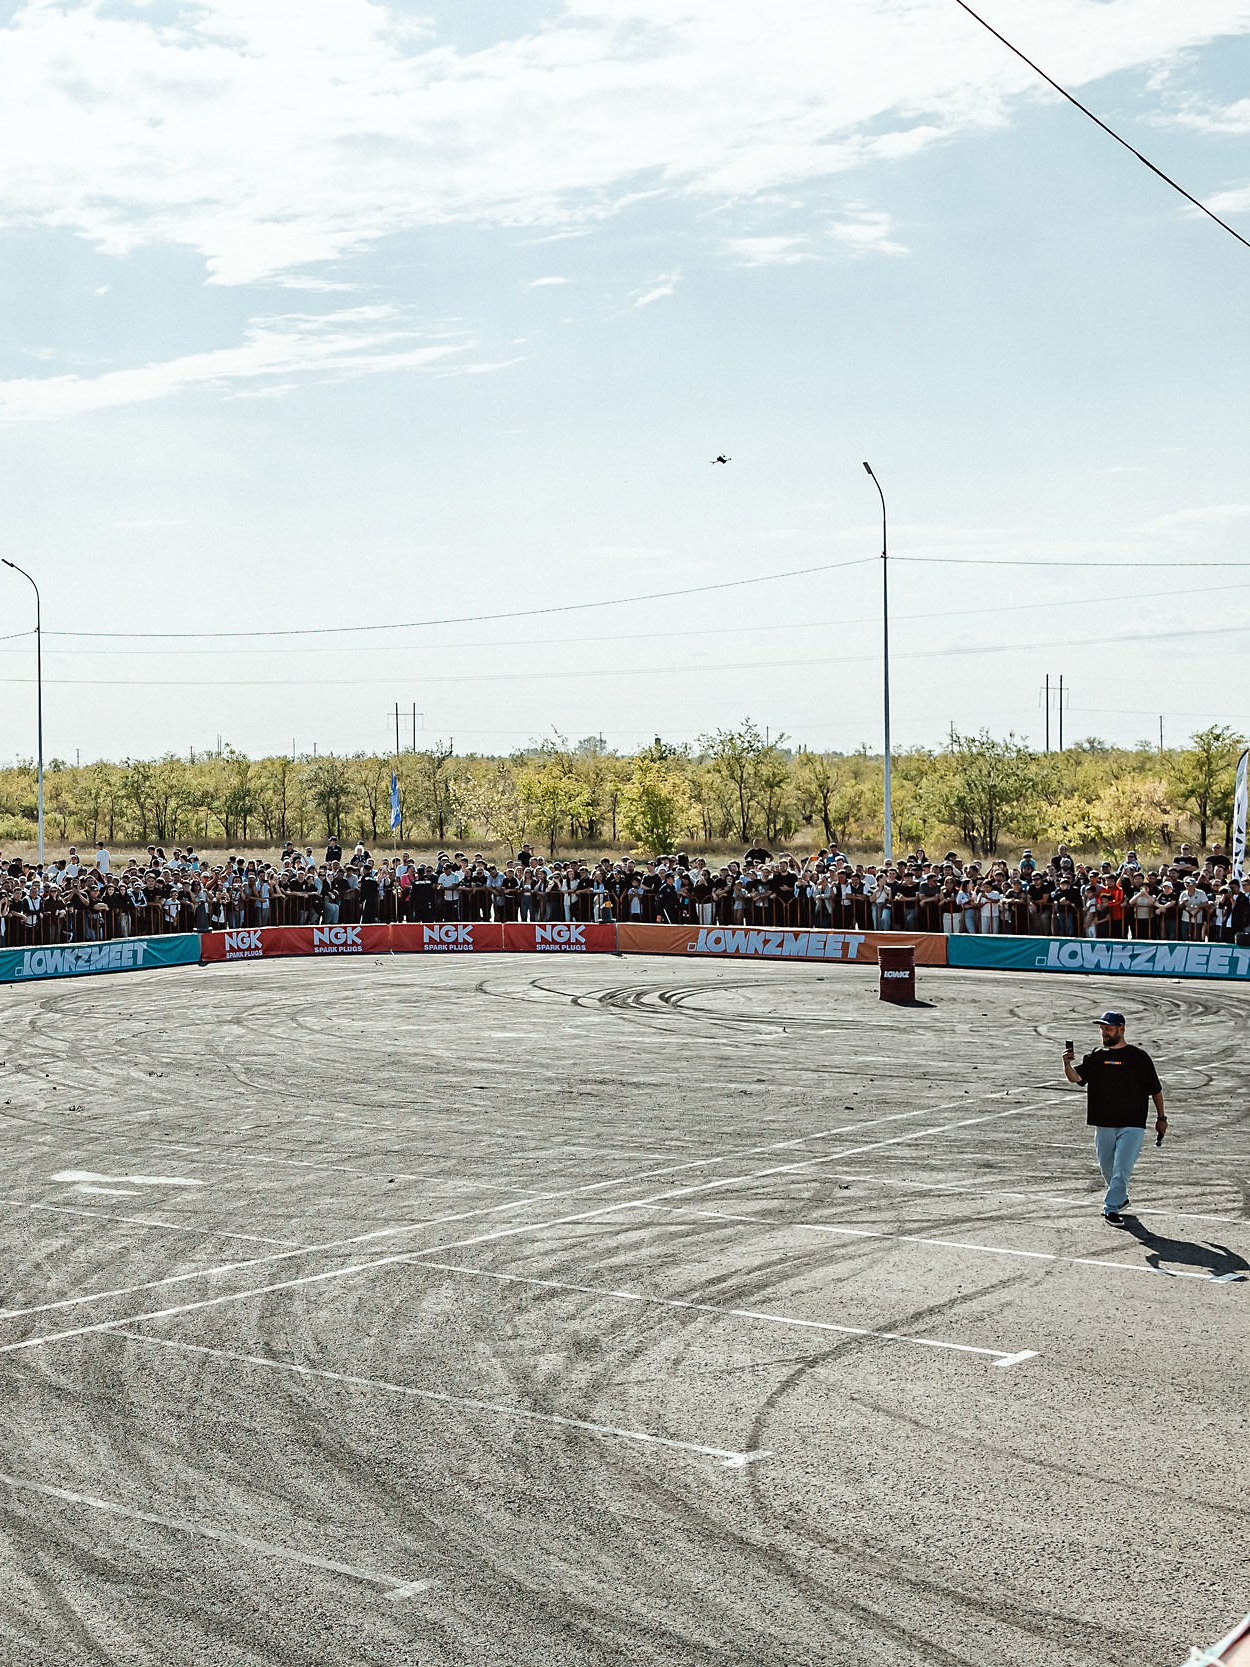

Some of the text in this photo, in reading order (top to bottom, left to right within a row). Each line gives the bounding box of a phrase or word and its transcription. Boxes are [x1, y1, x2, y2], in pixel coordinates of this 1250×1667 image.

[224, 929, 263, 951] NGK
[313, 926, 362, 946] NGK
[423, 924, 474, 943] NGK
[535, 924, 586, 943] NGK
[696, 929, 866, 958] LOWKZMEET
[22, 941, 148, 976] LOWKZMEET
[1047, 941, 1250, 975] LOWKZMEET
